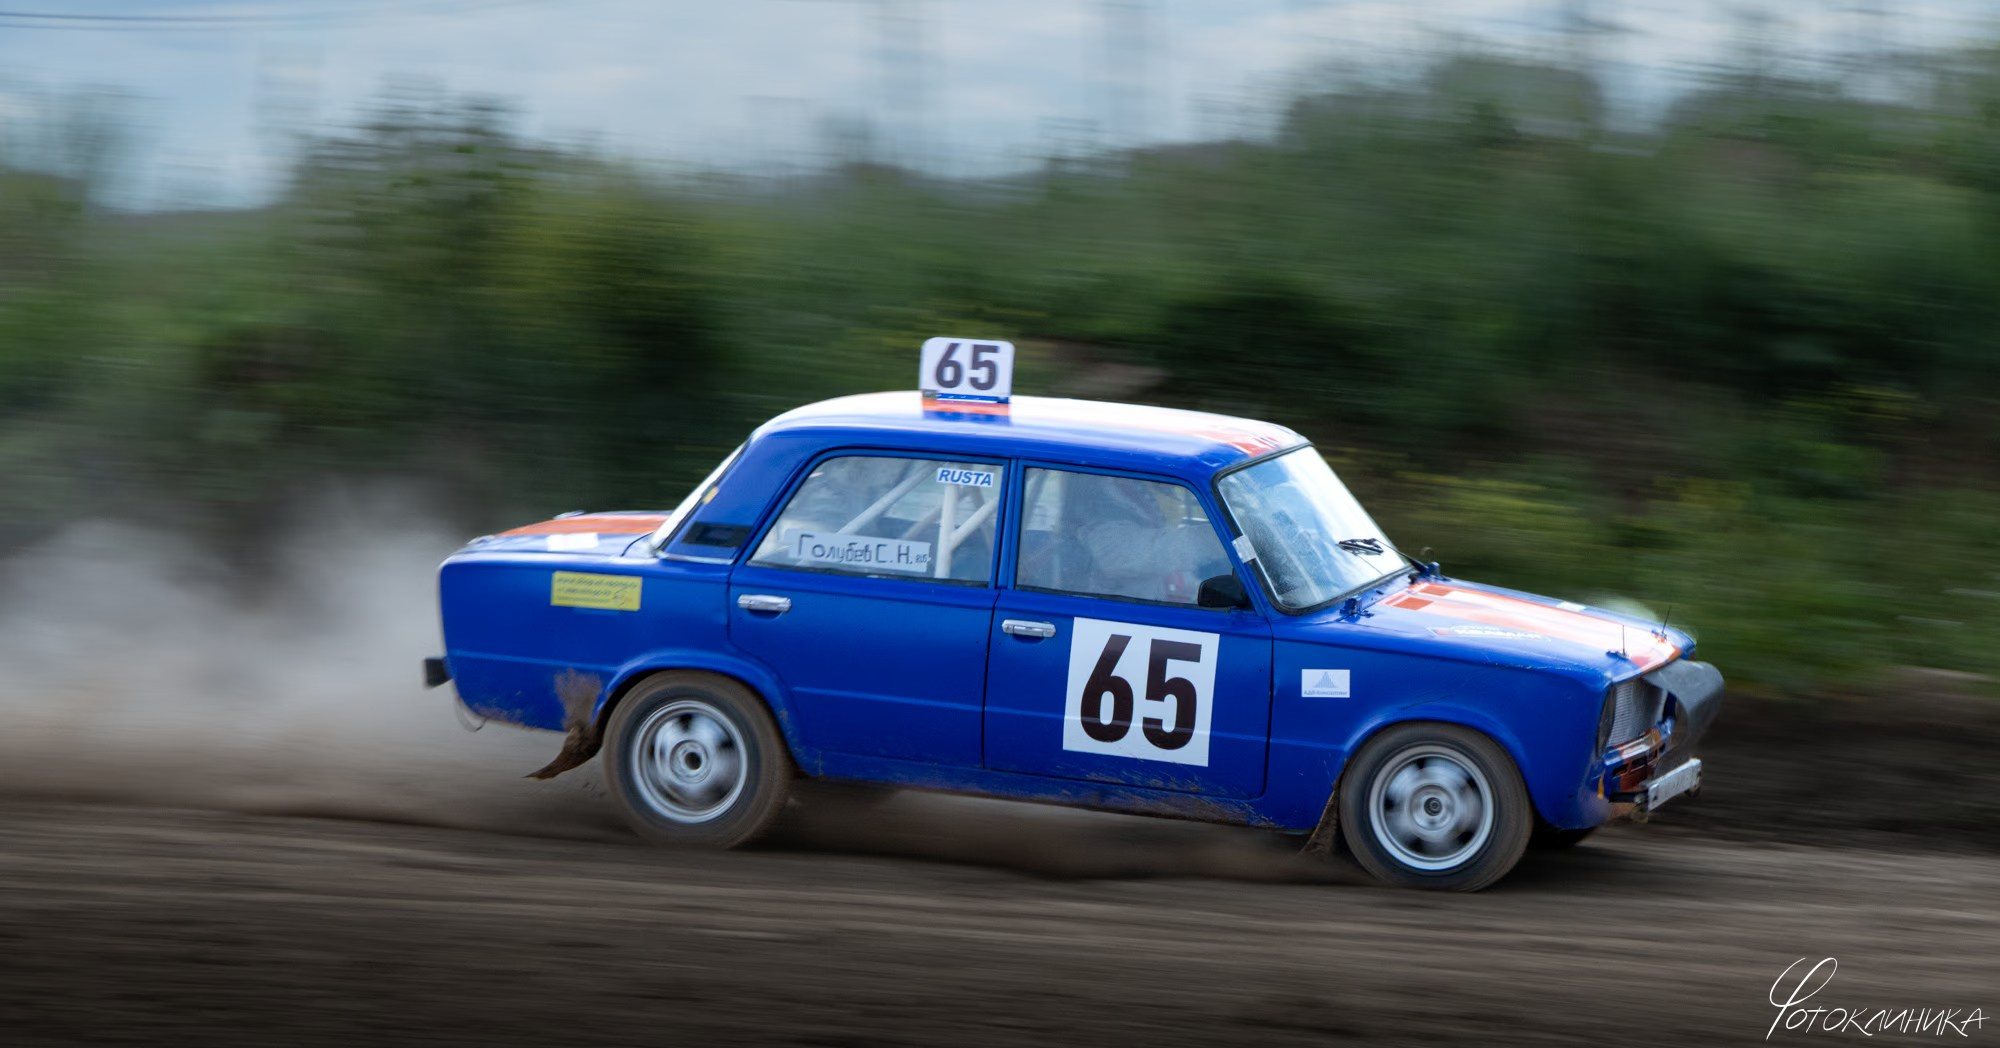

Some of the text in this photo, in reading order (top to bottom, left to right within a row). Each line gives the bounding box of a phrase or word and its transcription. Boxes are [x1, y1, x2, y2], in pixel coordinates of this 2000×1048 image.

[935, 342, 1000, 391] 65
[938, 469, 993, 487] RUSTA
[797, 533, 872, 563] Голубев
[1080, 633, 1202, 751] 65
